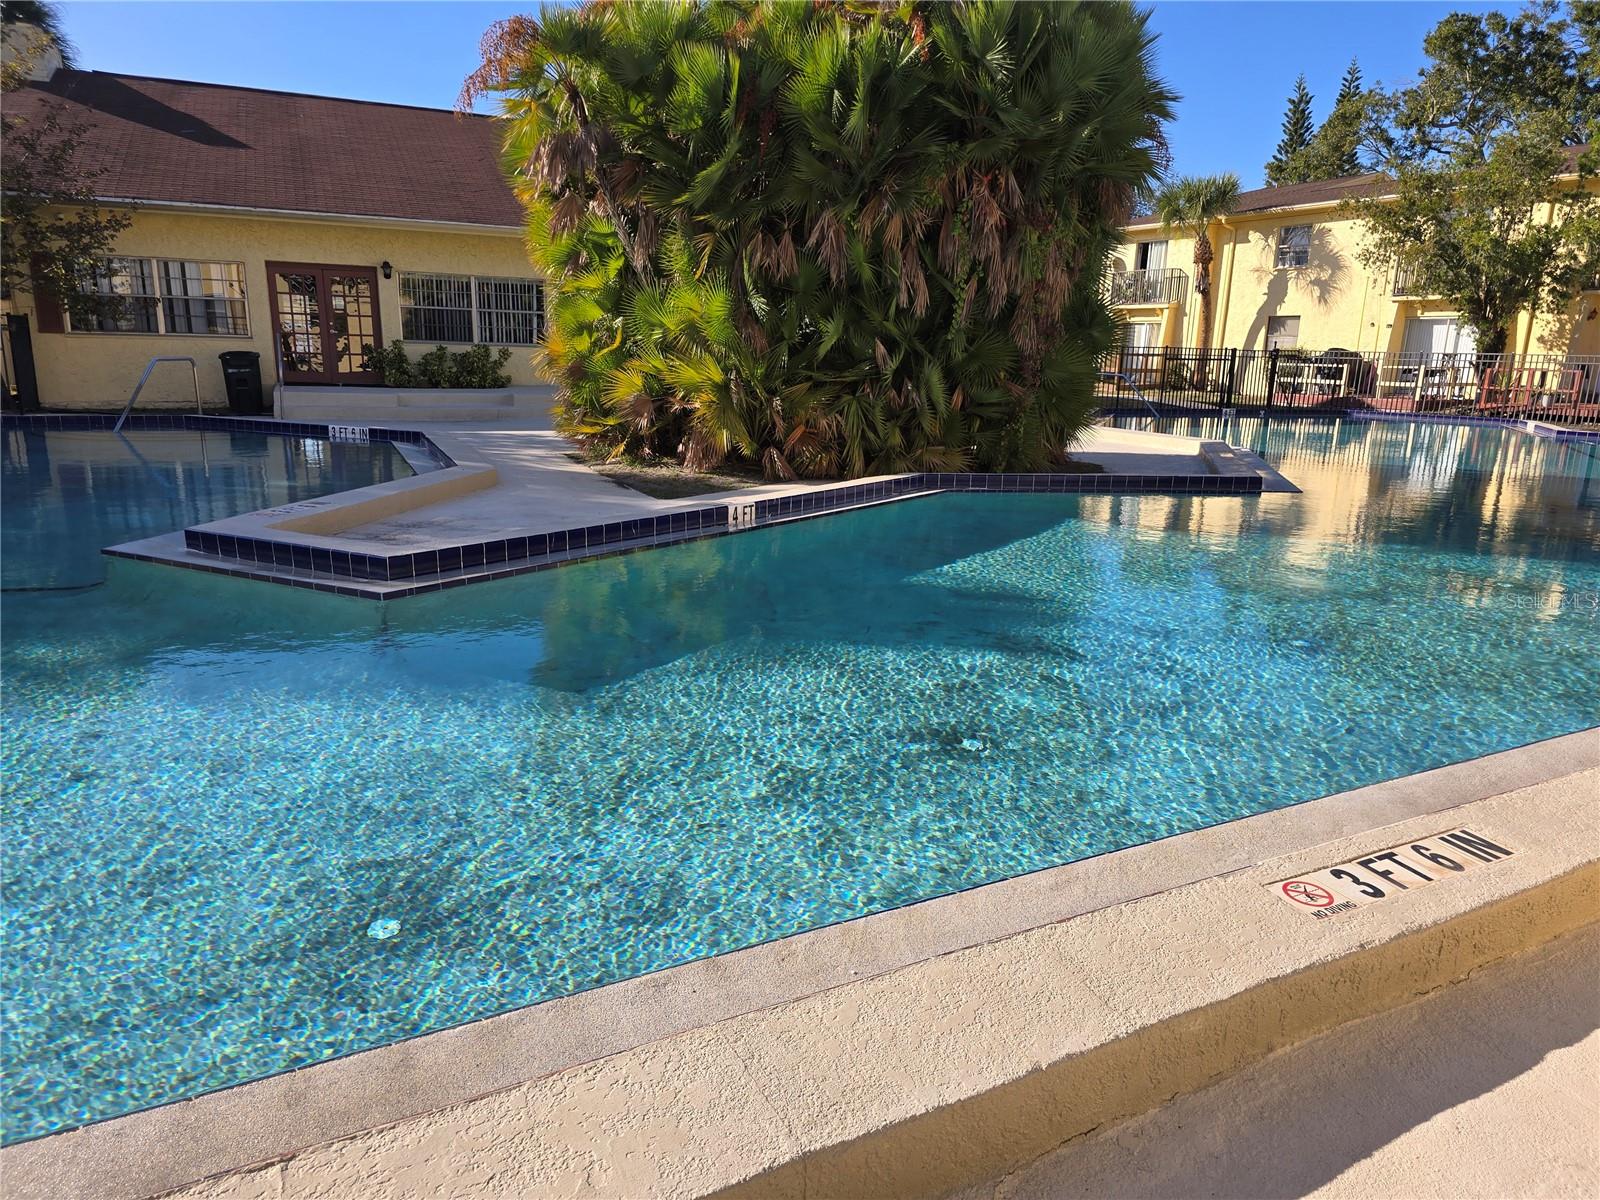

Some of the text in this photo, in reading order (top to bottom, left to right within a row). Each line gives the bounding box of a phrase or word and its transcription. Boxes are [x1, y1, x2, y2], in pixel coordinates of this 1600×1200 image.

[331, 426, 368, 441] 3 FT 6 IN
[732, 504, 754, 526] 4 FT
[1330, 829, 1515, 898] 3 FT 6 IN
[1311, 900, 1357, 919] NO DIVING
